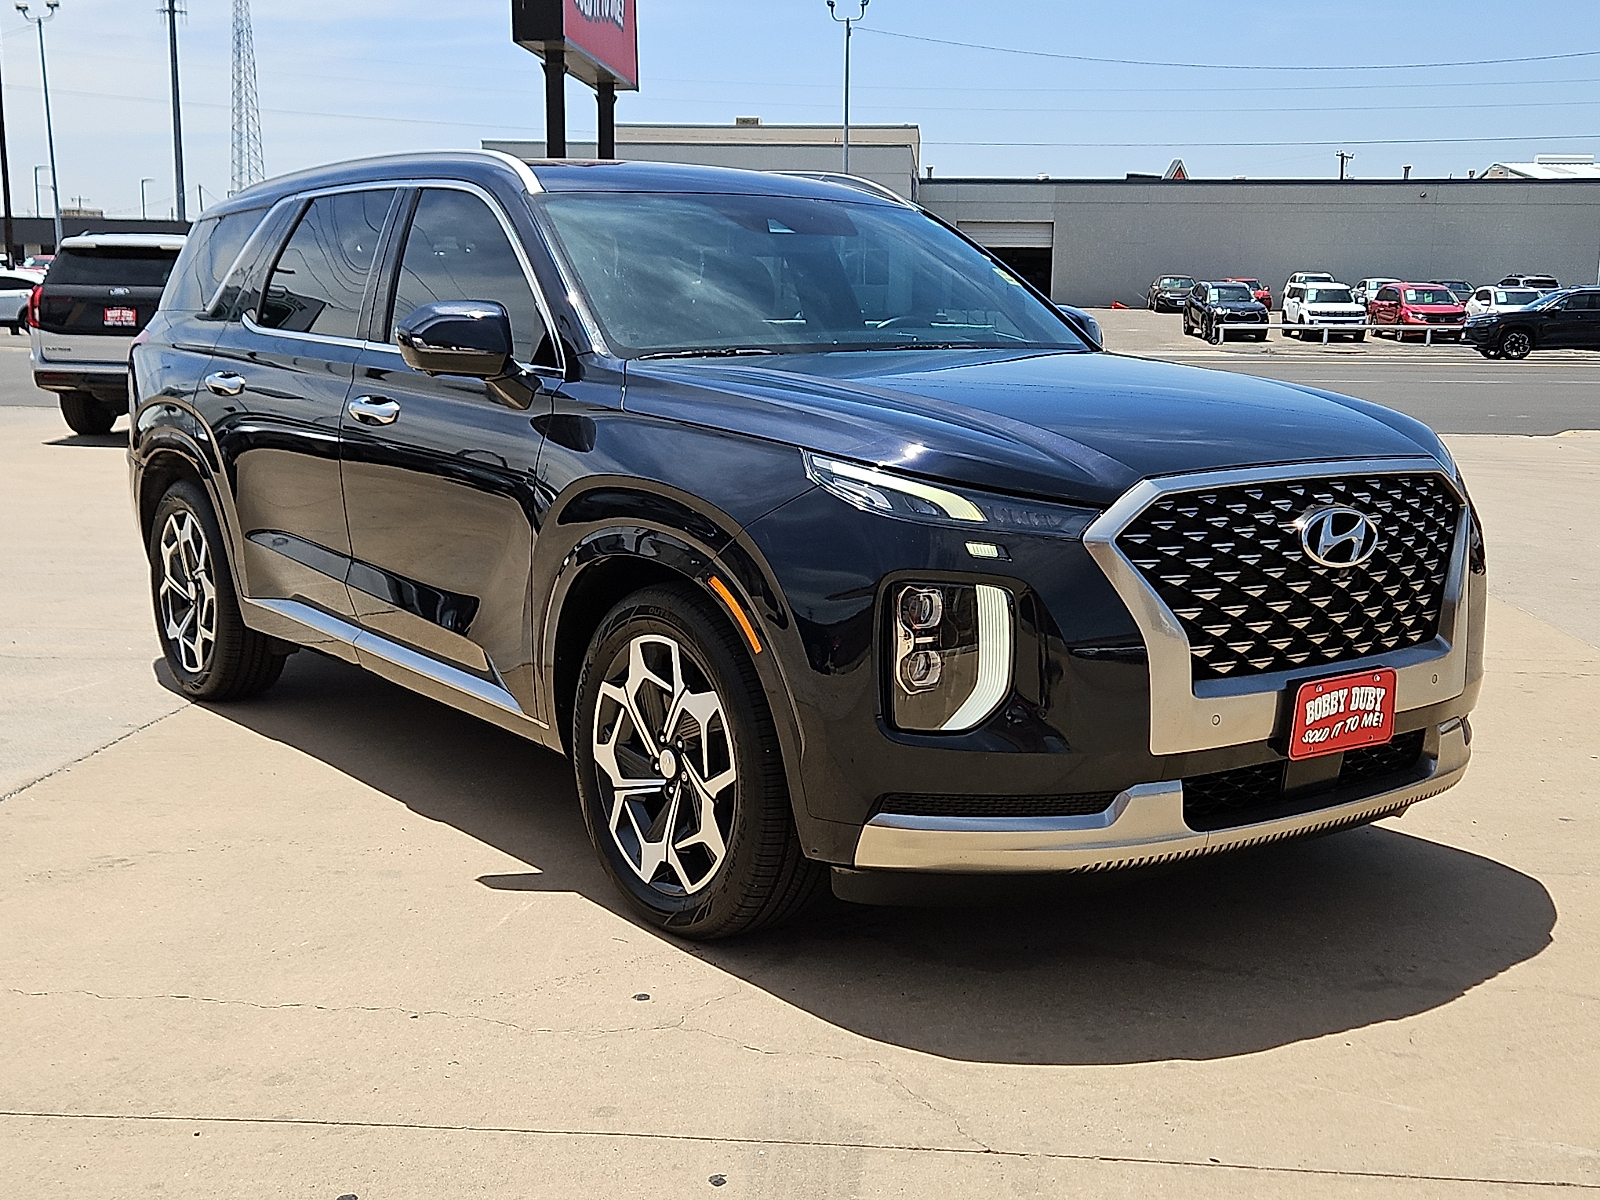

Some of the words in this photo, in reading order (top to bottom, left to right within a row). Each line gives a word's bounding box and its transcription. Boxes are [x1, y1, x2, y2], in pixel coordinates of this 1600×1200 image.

[1305, 688, 1349, 726] BOBBY
[1349, 686, 1386, 712] DUBY
[1301, 727, 1330, 744] SOLD
[1330, 721, 1345, 739] IT
[1344, 715, 1360, 733] TO
[1360, 711, 1384, 728] ME!
